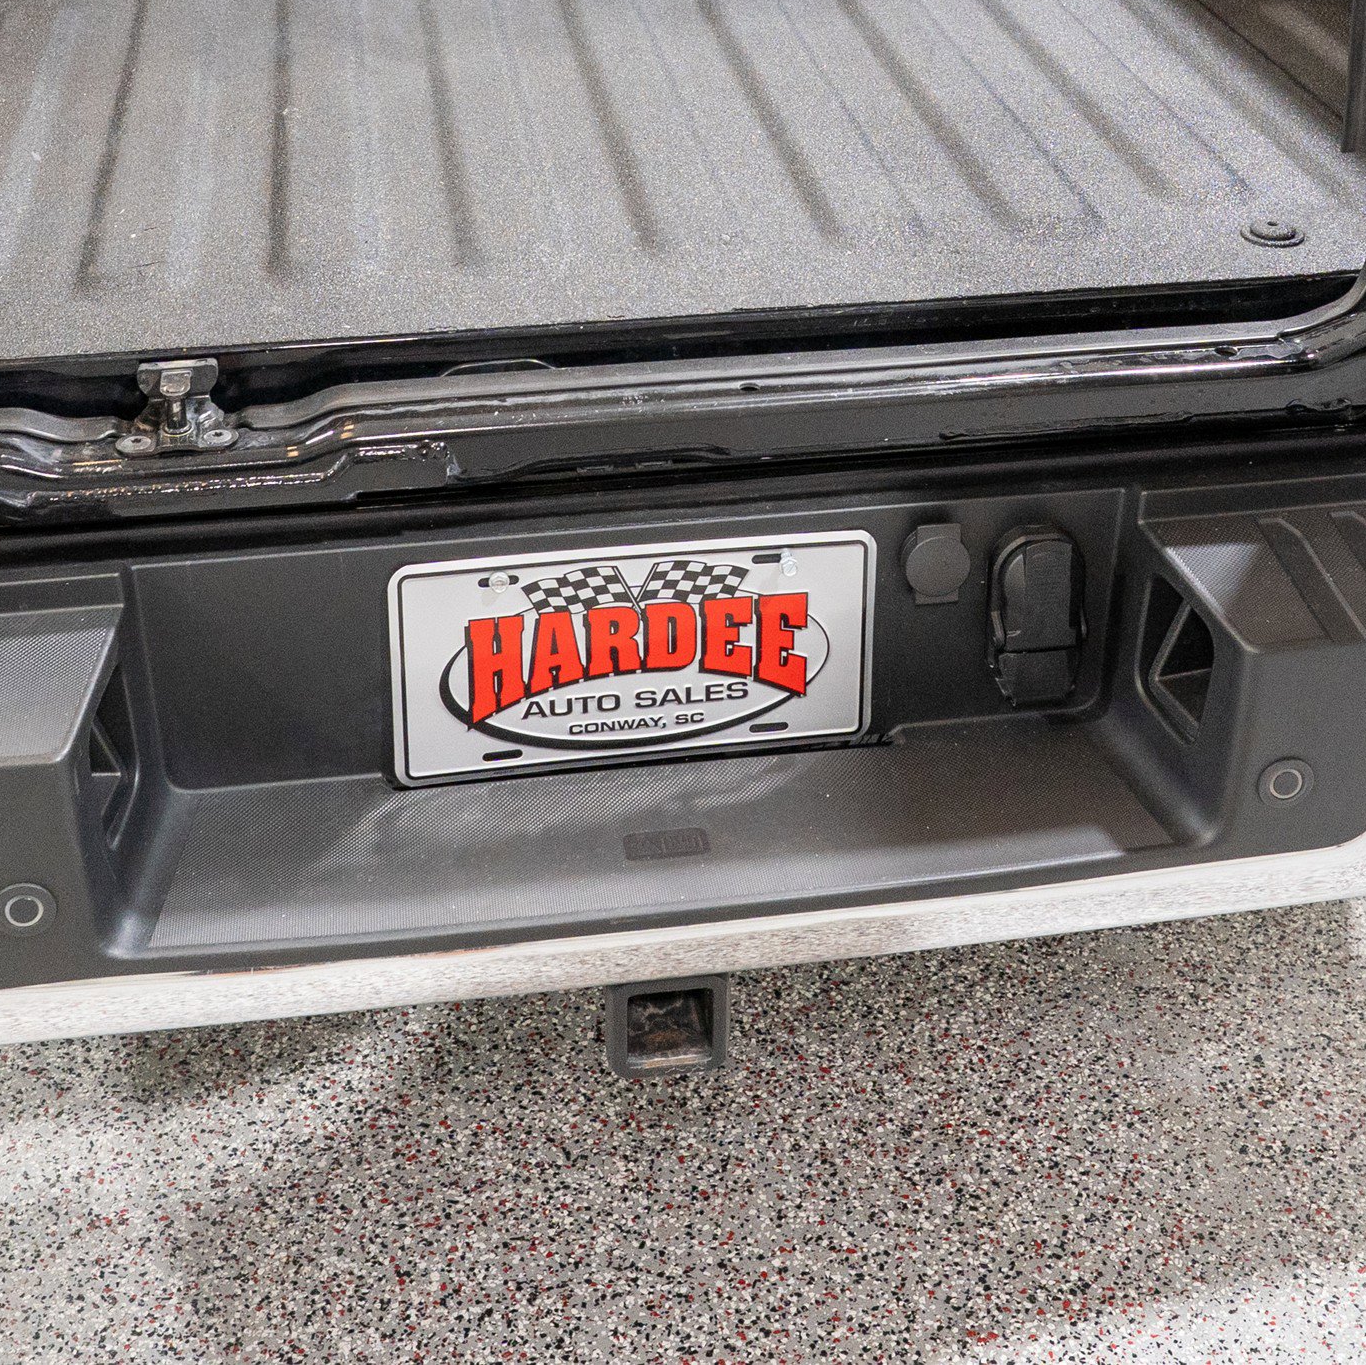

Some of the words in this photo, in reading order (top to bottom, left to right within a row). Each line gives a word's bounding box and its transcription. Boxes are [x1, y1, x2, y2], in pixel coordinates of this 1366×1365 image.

[465, 592, 809, 730] HARDEE
[521, 692, 621, 720] AUTO
[634, 680, 749, 709] SALES
[568, 716, 667, 736] CONWAY,
[674, 711, 705, 725] SC
